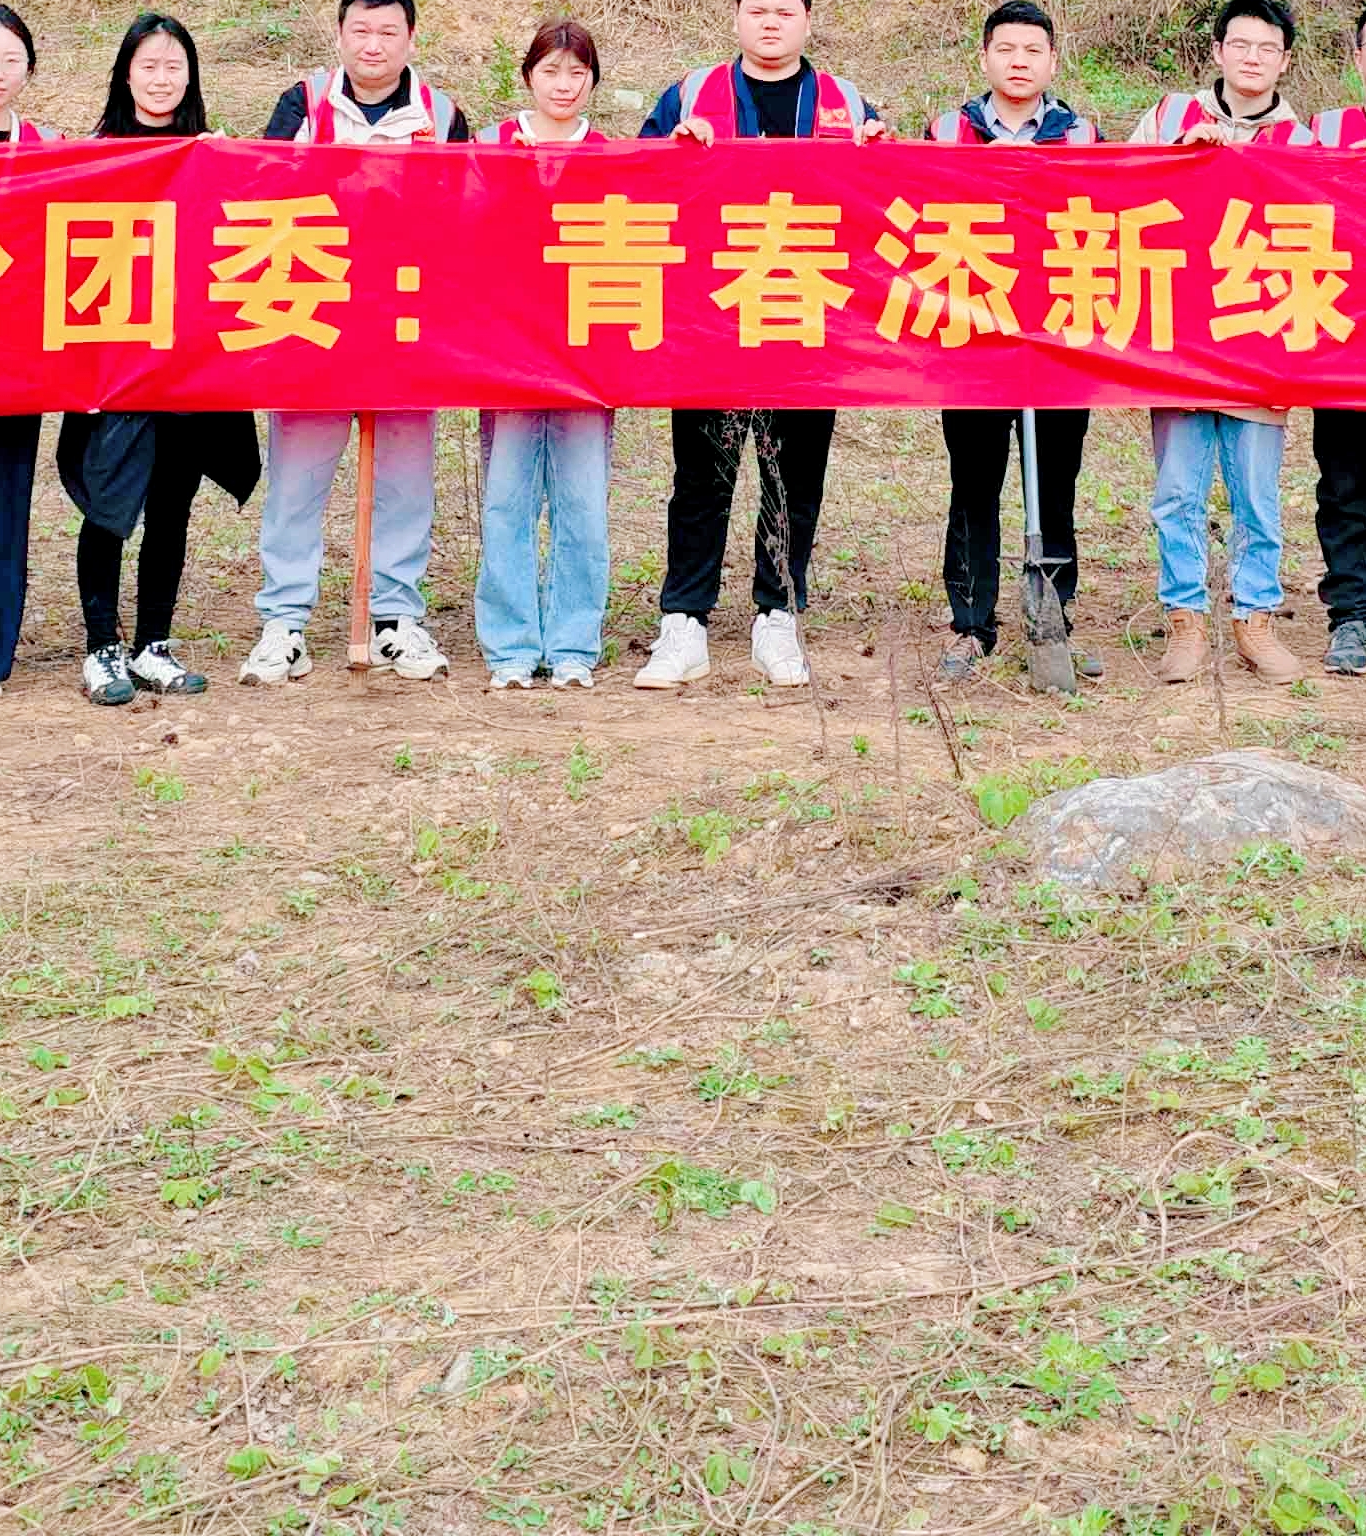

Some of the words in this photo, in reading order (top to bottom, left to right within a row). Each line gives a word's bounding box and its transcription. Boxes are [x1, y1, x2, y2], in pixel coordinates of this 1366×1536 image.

[542, 191, 1356, 353] 青春添新绿
